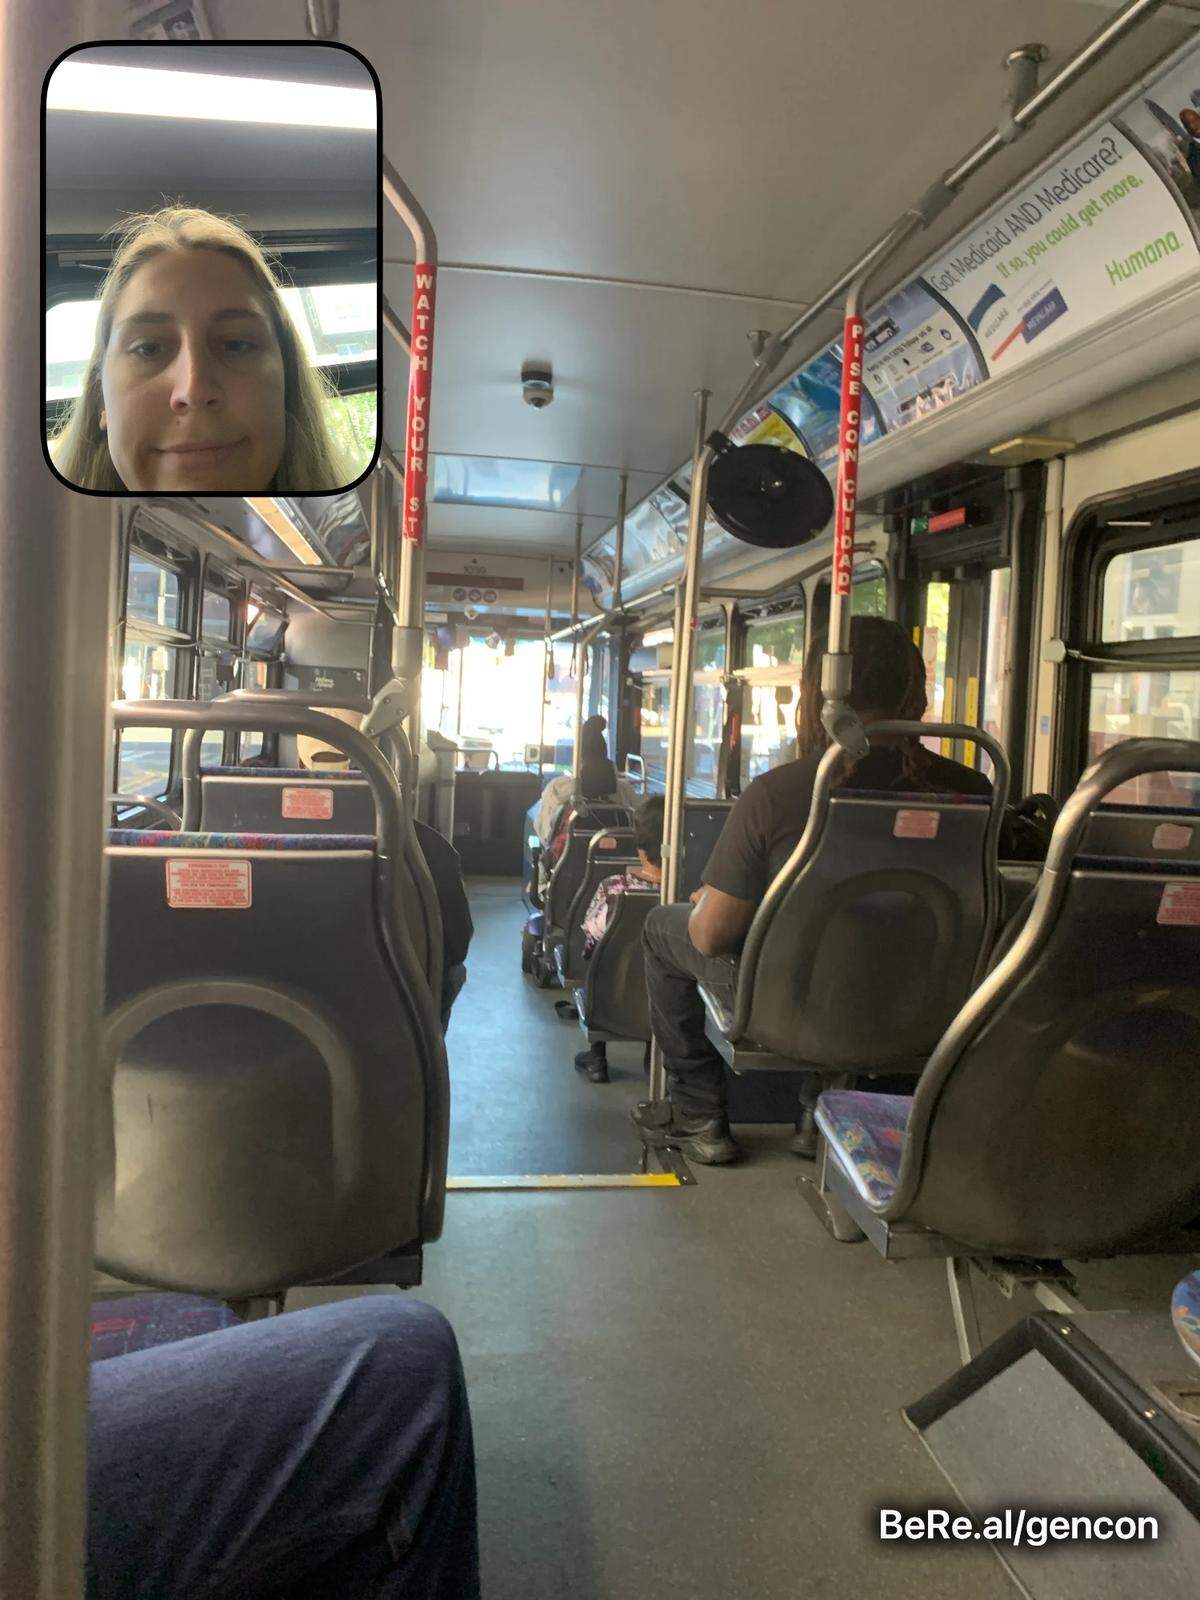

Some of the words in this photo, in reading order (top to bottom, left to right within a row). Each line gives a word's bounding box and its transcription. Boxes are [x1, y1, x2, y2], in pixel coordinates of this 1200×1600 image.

[931, 264, 960, 292] Got
[951, 227, 1011, 278] Medicaid
[1004, 200, 1043, 239] AND
[1036, 137, 1123, 211] Medicare?
[996, 263, 1010, 279] If
[1024, 240, 1047, 266] you
[1045, 213, 1080, 246] could
[1078, 199, 1104, 227] get
[1102, 172, 1144, 207] more.
[1104, 230, 1181, 286] Humana
[415, 274, 433, 371] WATCH
[849, 324, 863, 396] PISE
[411, 396, 426, 472] YOUR
[845, 411, 858, 463] CON
[407, 497, 419, 544] ST
[838, 479, 855, 596] CUIDAD
